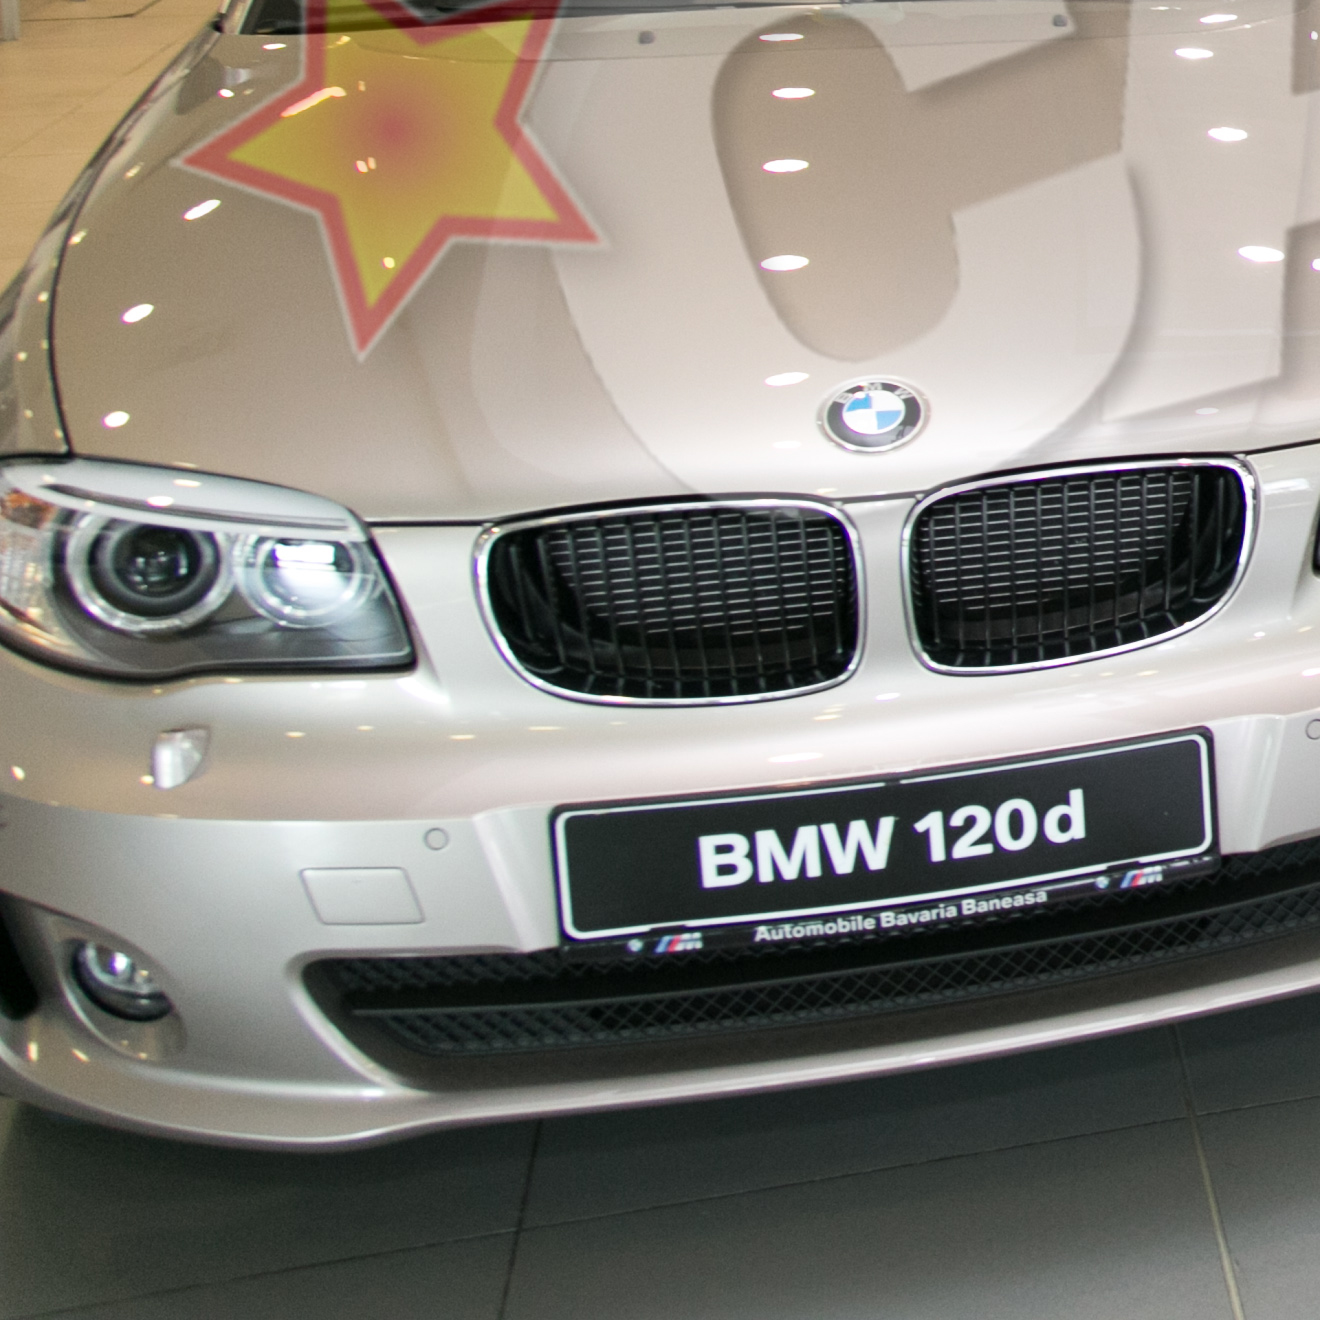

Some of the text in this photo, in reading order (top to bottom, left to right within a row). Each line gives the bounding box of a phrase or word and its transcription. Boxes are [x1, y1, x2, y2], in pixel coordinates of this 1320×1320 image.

[699, 788, 1086, 888] BMW 120d
[754, 890, 1048, 942] Automobile Bavaria Baneasa
